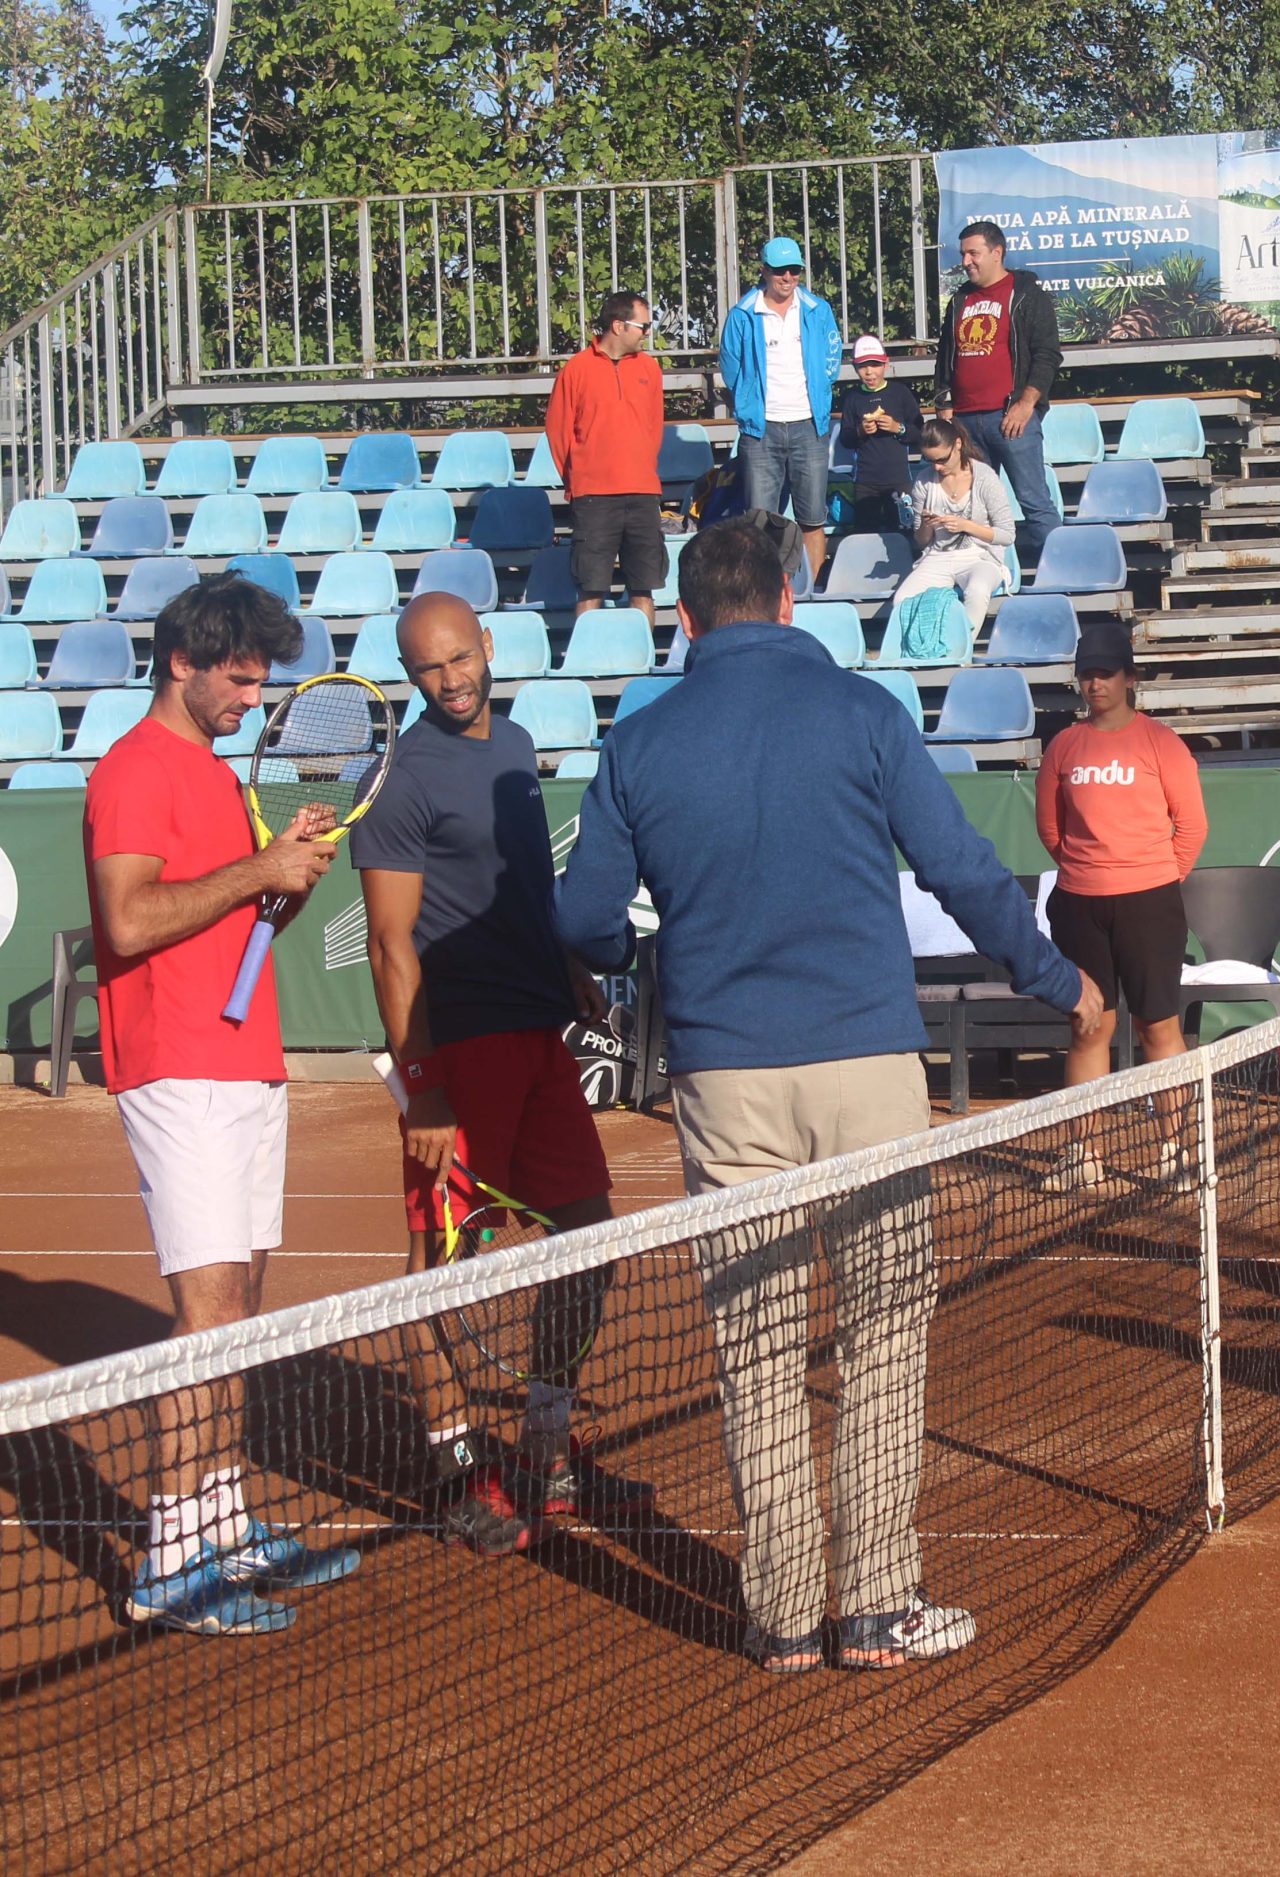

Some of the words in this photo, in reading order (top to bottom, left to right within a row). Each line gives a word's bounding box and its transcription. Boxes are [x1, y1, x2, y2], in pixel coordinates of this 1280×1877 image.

[1030, 206, 1072, 227] APĂ
[1078, 199, 1192, 224] MINERALĂ
[1039, 234, 1064, 249] DE
[1071, 231, 1098, 248] LA
[1102, 227, 1190, 250] TUȘNAD
[1074, 271, 1166, 290] VULCANICĂ
[1070, 759, 1135, 785] andu
